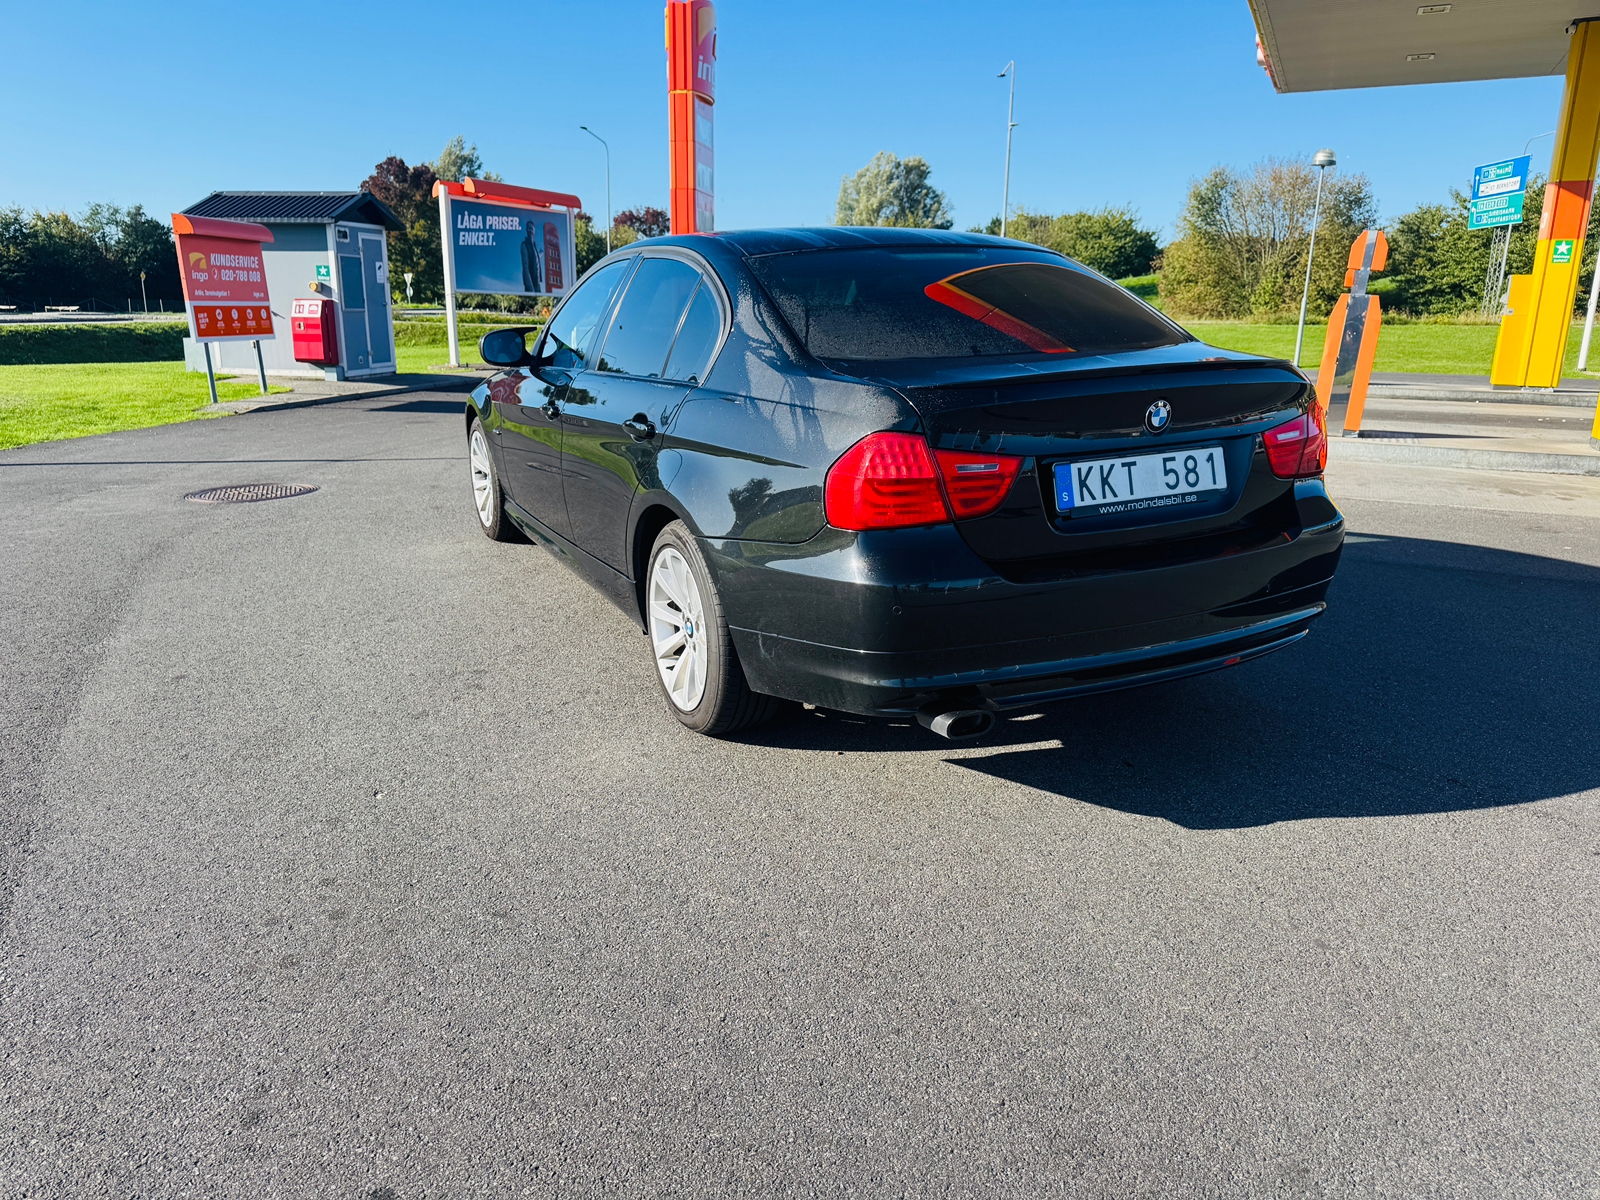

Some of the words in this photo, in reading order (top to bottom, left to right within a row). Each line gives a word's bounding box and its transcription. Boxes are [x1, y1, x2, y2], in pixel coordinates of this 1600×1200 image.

[457, 210, 483, 229] LÅGA
[486, 215, 522, 230] PRISER.
[1541, 212, 1548, 229] 3
[459, 231, 496, 246] ENKELT.
[210, 253, 259, 268] KUNDSERVICE
[191, 269, 209, 282] ingo
[221, 269, 248, 281] 020-788
[1062, 492, 1068, 501] S
[1077, 461, 1137, 502] KKT
[1162, 452, 1217, 490] 581
[1099, 493, 1198, 514] www.molndalsbil.se
